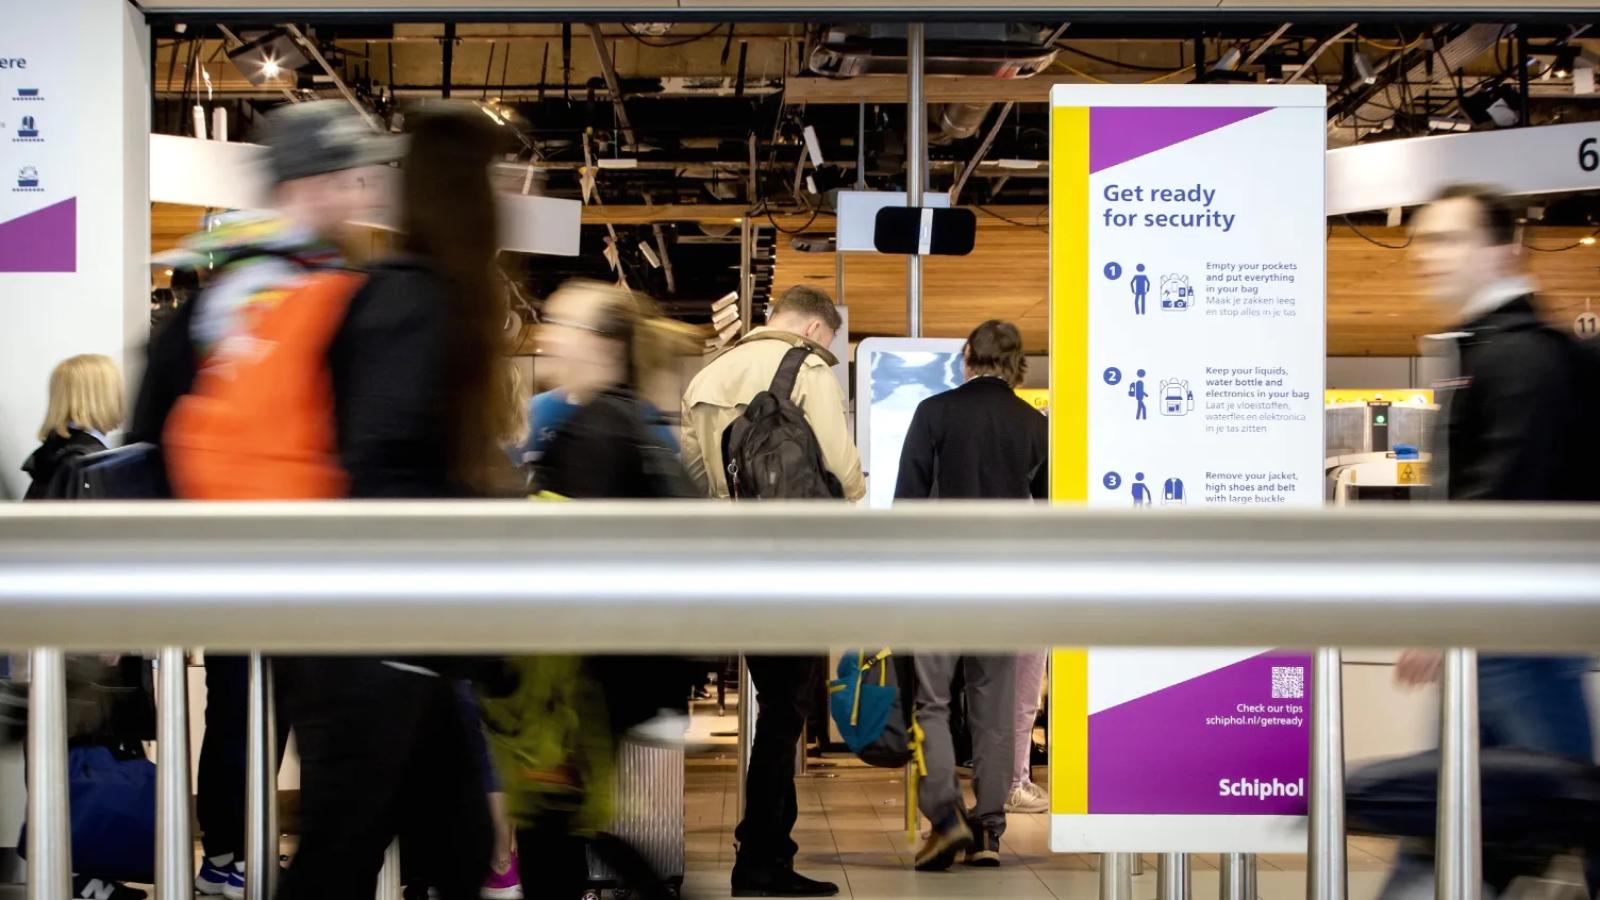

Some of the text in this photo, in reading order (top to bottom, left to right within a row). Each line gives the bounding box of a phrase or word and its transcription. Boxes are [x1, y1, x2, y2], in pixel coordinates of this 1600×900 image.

[1578, 137, 1600, 172] 6
[1103, 184, 1216, 207] Get ready
[1103, 208, 1235, 232] for security
[1206, 262, 1298, 271] Empty your pockets
[1206, 273, 1295, 283] and put everything
[1206, 285, 1259, 295] in your bag
[1206, 296, 1296, 306] Maak je zakken leeg
[1219, 308, 1239, 318] stop
[1240, 308, 1260, 316] alles
[1283, 308, 1296, 316] tas
[1577, 317, 1597, 333] 11
[1206, 367, 1288, 376] Keep your liquids,
[1235, 378, 1263, 386] bottle
[1265, 378, 1283, 386] and
[1206, 389, 1310, 400] electronics in your bag
[1206, 401, 1225, 410] Laat
[1226, 402, 1235, 411] je
[1205, 413, 1245, 421] waterfles
[1259, 413, 1306, 421] elektronica
[1206, 425, 1267, 434] in je tas zitten
[1206, 472, 1298, 481] Remove your jacket,
[1206, 483, 1296, 493] high shoes and belt
[1205, 494, 1285, 504] with large buckle
[1236, 703, 1303, 714] Check our tips
[1206, 715, 1303, 727] schiphol.nl/getready
[1219, 777, 1304, 800] Schiphol
